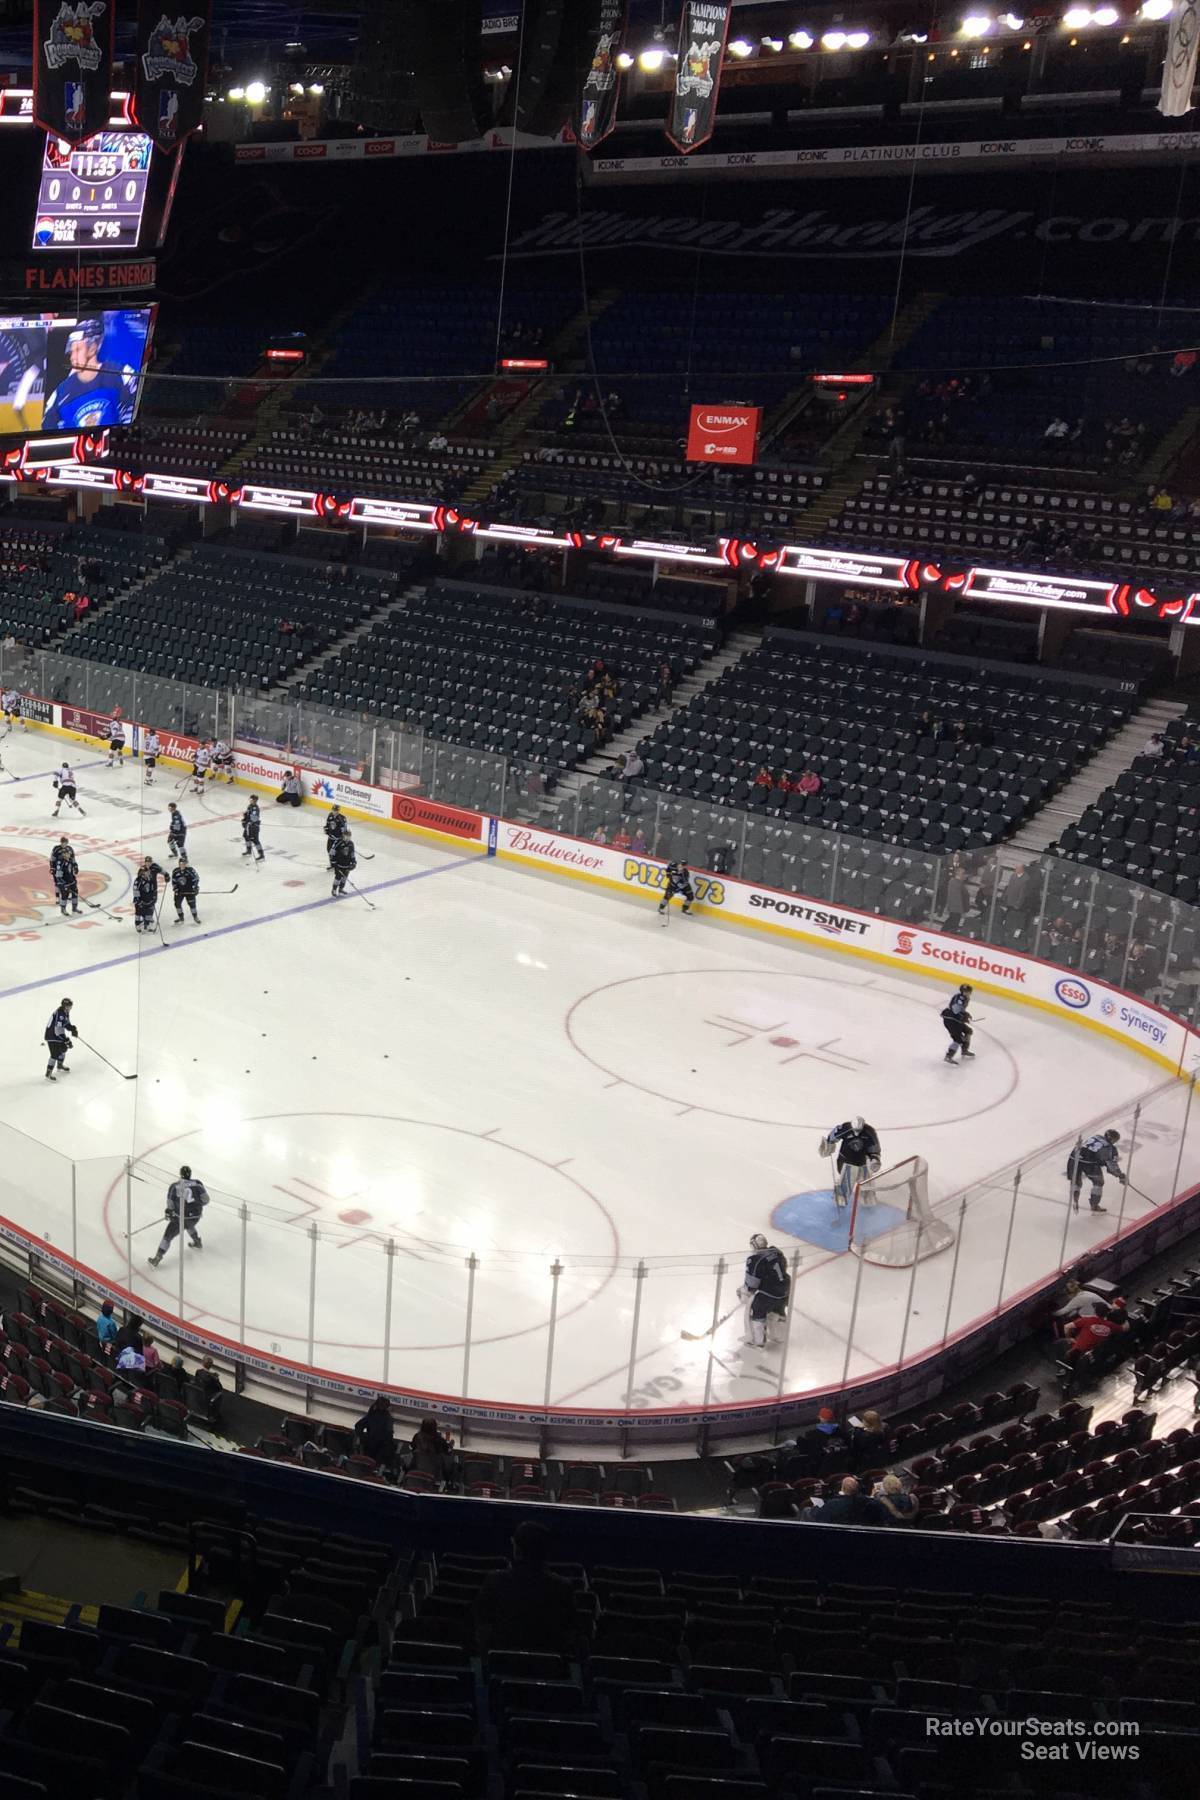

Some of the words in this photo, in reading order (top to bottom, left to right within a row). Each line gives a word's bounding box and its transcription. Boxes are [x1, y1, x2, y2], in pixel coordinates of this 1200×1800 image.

[797, 150, 828, 161] ICONIC
[843, 147, 916, 161] PLATINUM
[921, 145, 961, 157] CLUB
[980, 142, 1017, 154] ICONIC
[77, 155, 117, 176] 11:35
[660, 158, 688, 168] ICONIC
[49, 179, 60, 201] 0
[125, 180, 136, 201] 0
[53, 230, 76, 241] TOTAL
[54, 219, 77, 231] 50/50
[25, 266, 105, 289] FLAMES
[706, 415, 750, 426] ENMAX
[344, 786, 372, 802] Chesney
[417, 809, 477, 833] WARRIOR
[507, 827, 604, 870] Budweiser
[694, 876, 725, 905] 73
[748, 894, 871, 936] SPORTSNET
[921, 941, 1027, 985] Scotiabank
[1119, 1007, 1168, 1044] Synergy
